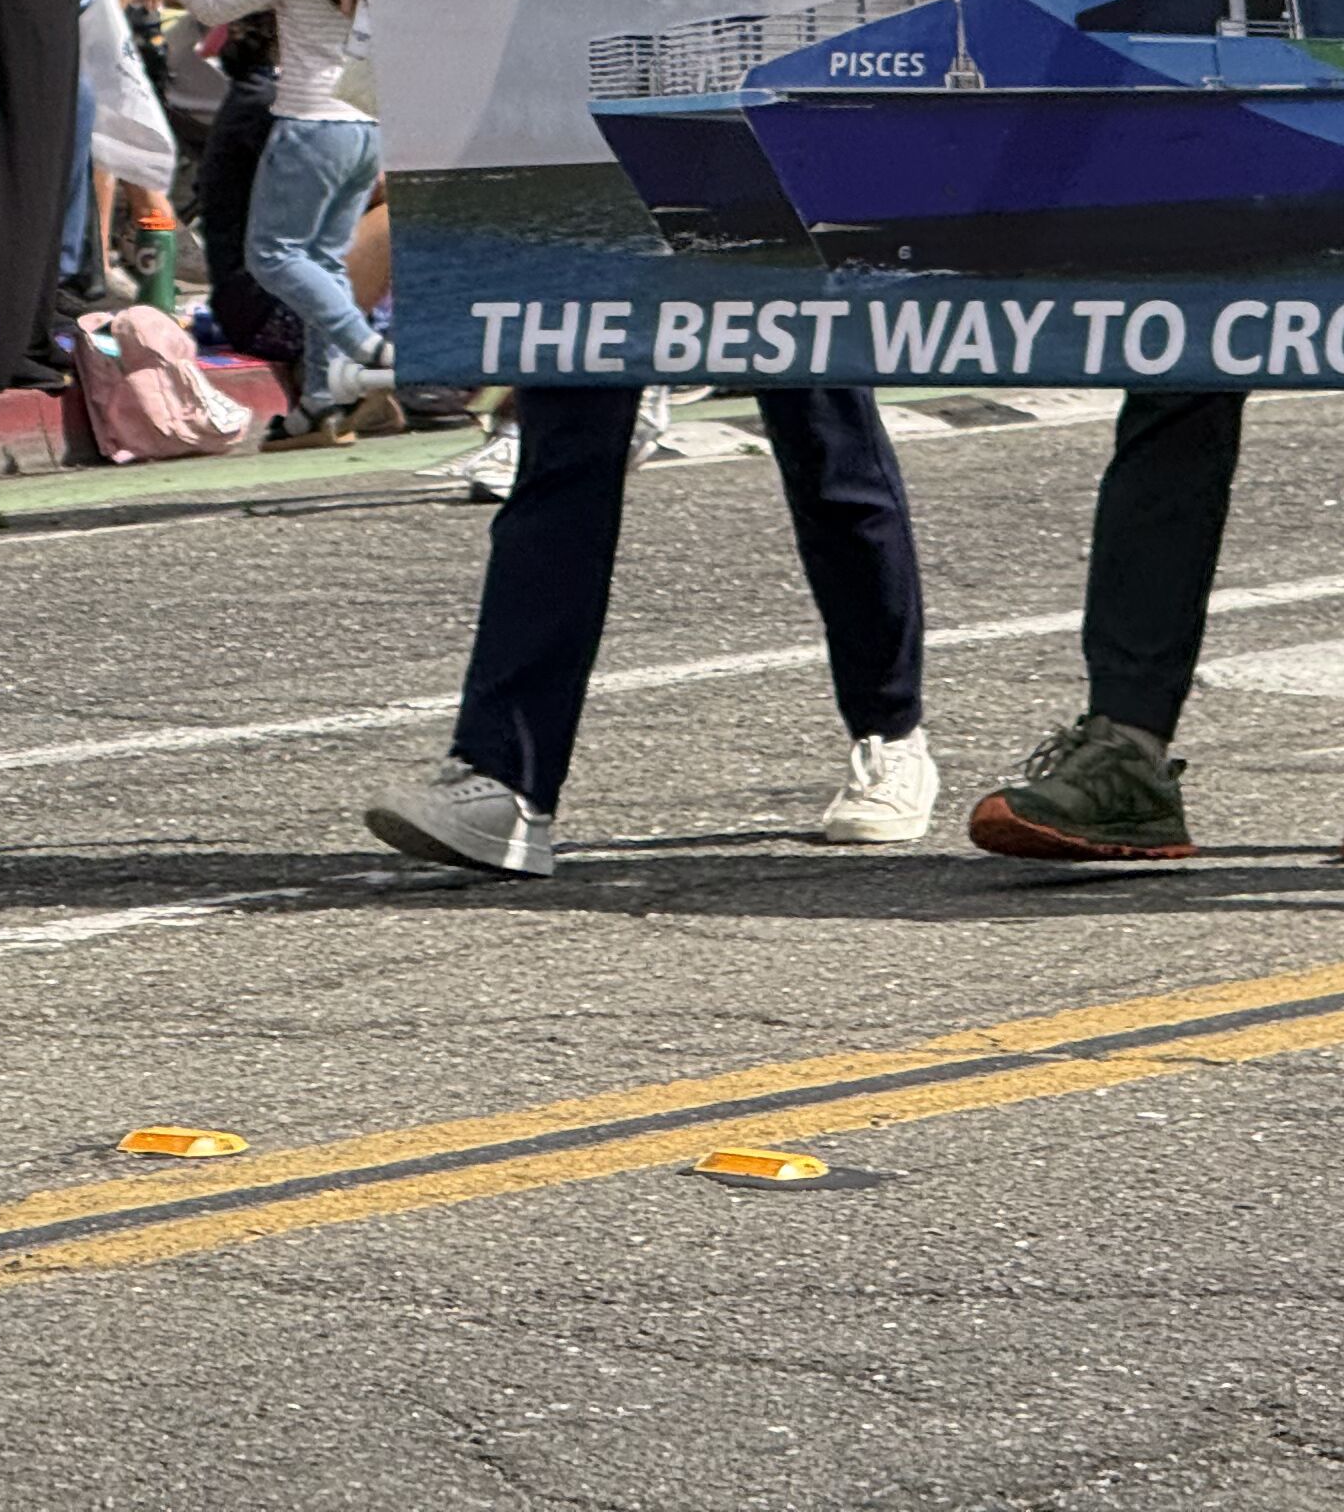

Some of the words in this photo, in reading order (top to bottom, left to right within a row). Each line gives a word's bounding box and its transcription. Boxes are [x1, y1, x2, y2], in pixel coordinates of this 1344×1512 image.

[830, 52, 925, 77] PISCES
[470, 300, 632, 375] THE
[654, 299, 850, 375] BEST
[867, 299, 1056, 375] WAY
[1072, 299, 1186, 376] TO
